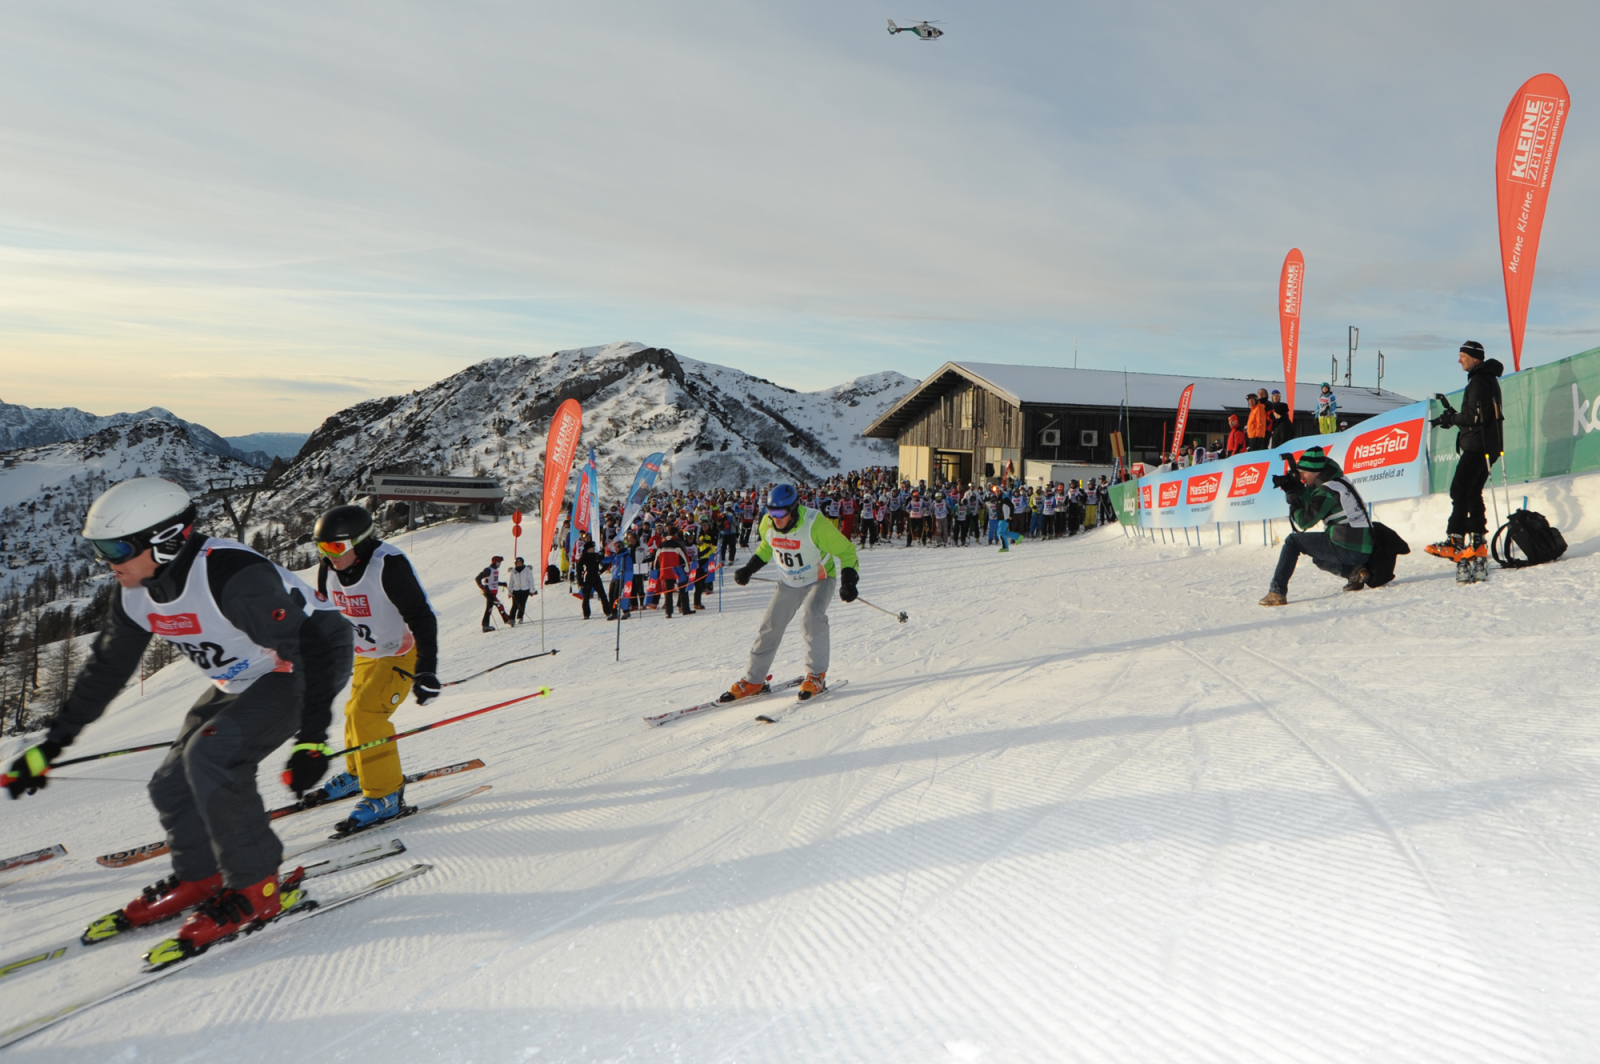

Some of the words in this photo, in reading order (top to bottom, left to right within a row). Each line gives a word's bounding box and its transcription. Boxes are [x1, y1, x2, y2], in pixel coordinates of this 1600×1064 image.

[1512, 100, 1541, 178] KLEINE
[1527, 101, 1554, 181] ZEITUNG
[1541, 99, 1566, 188] www.kleinezeitung.at
[1508, 235, 1524, 274] Meine
[1517, 189, 1534, 233] Kleine.
[1285, 264, 1294, 313] KLEINE
[552, 412, 570, 462] KLEINE
[1353, 434, 1409, 460] Nassfeld
[1351, 468, 1405, 485] www.nassfeld.at
[1352, 457, 1386, 470] Hermagor
